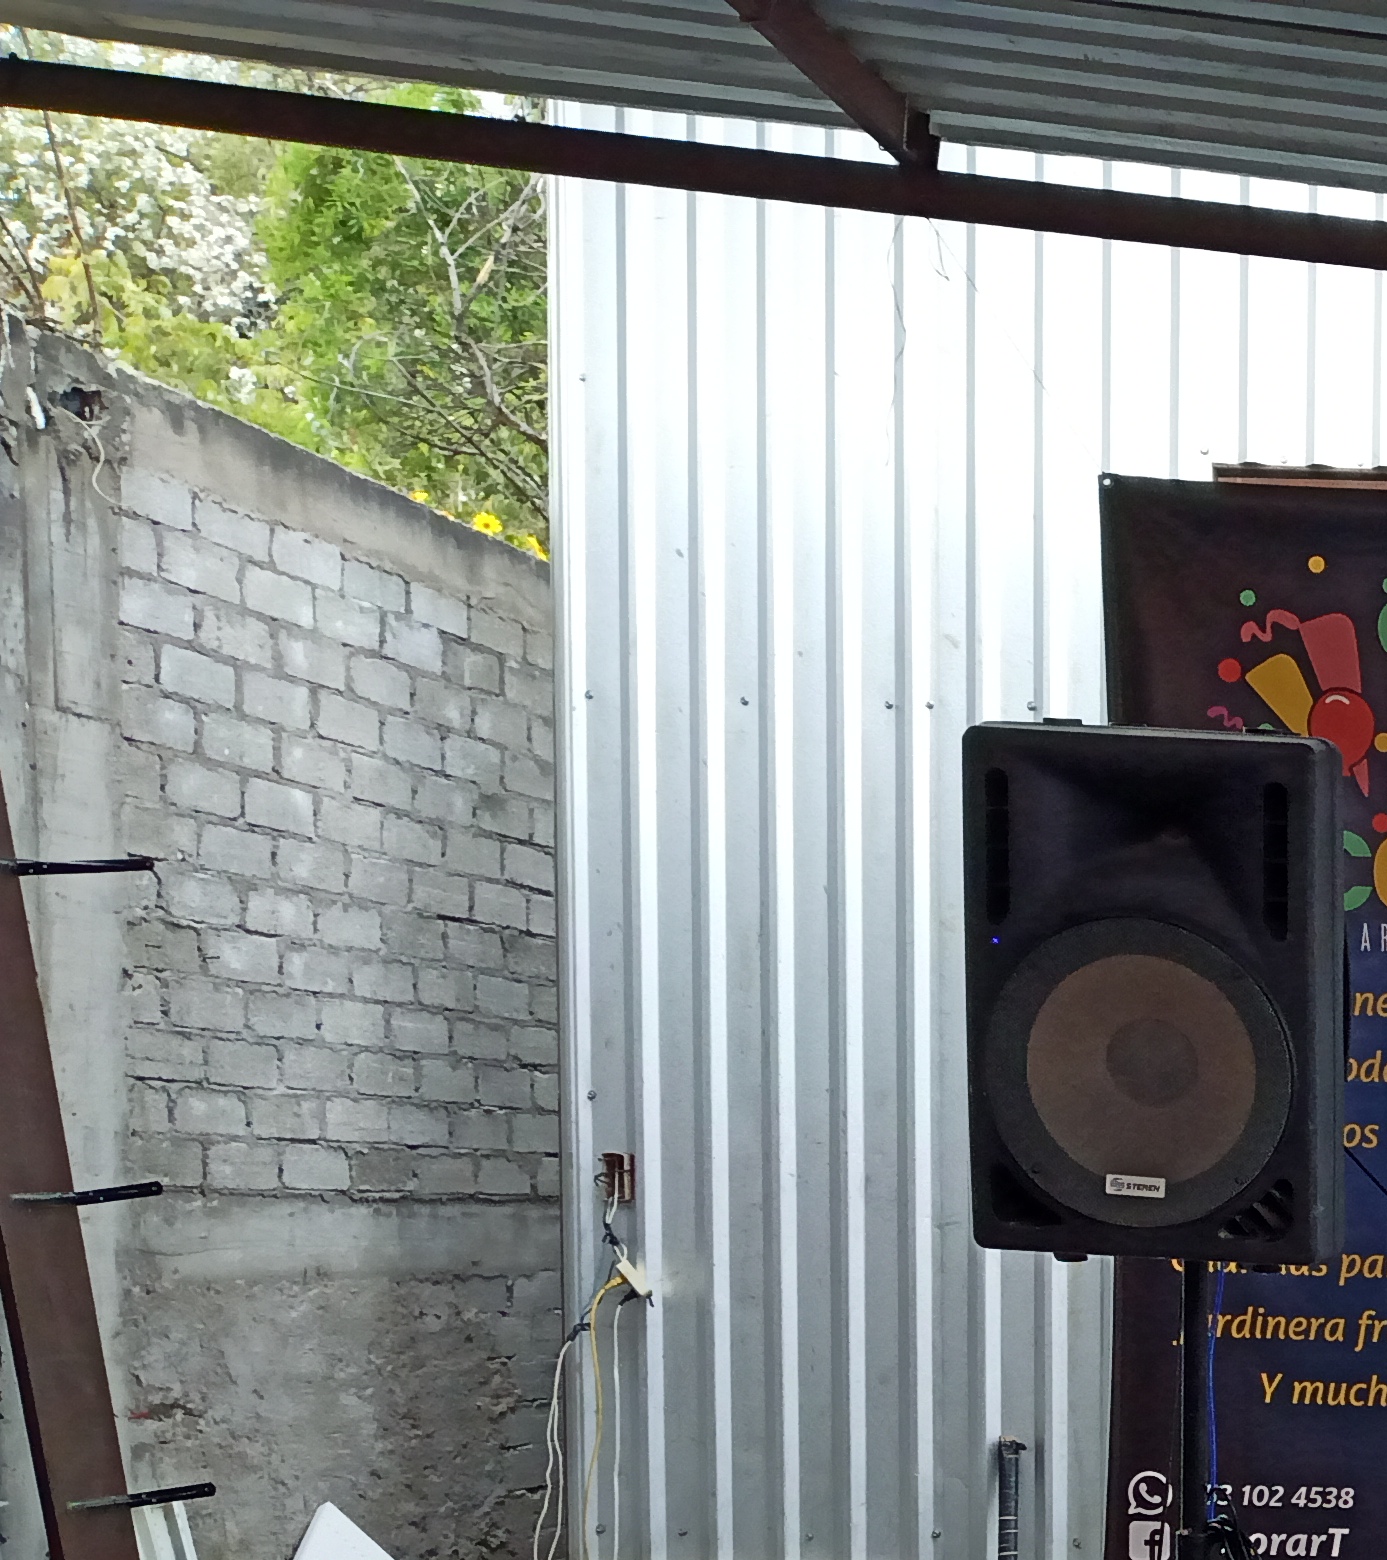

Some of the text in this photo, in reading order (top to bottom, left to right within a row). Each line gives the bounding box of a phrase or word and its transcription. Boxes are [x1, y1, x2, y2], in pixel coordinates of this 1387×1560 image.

[1126, 1182, 1161, 1193] STEREN
[1260, 1371, 1283, 1405] Y
[1241, 1484, 1285, 1508] 102
[1290, 1485, 1356, 1510] 4538
